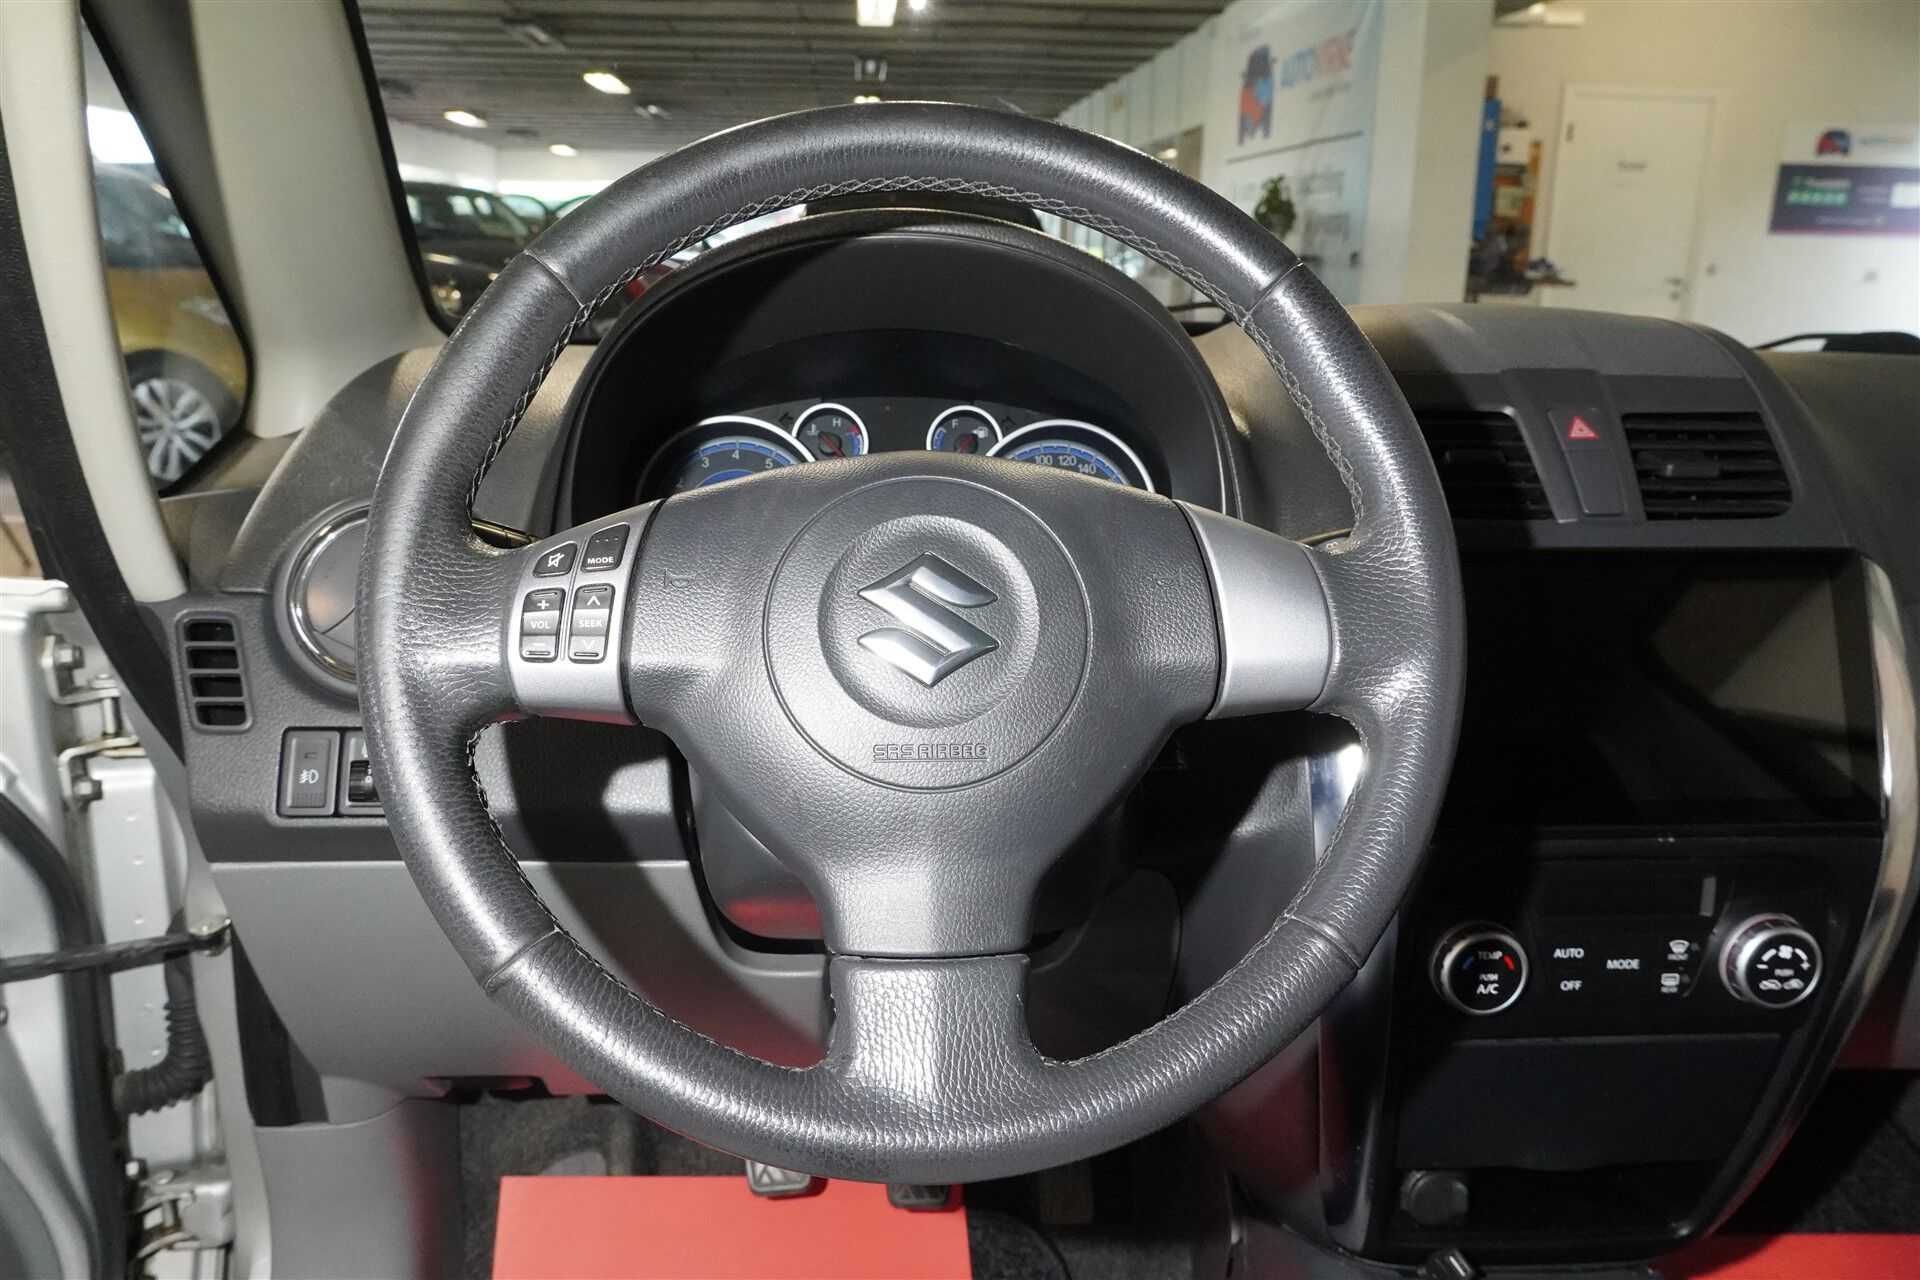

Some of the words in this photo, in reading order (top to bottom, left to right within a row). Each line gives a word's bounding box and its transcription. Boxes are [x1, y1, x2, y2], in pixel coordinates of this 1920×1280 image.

[832, 417, 842, 427] H
[951, 418, 960, 429] F
[731, 449, 740, 460] 4
[701, 457, 710, 468] 3
[765, 458, 774, 469] 5
[1034, 455, 1053, 466] 100
[1057, 455, 1077, 467] 120
[1077, 463, 1096, 475] 140
[587, 556, 614, 565] MODE
[530, 620, 551, 630] VOL
[577, 619, 603, 629] SEEK
[873, 743, 914, 759] SRS
[917, 743, 989, 759] AIRBAG
[1478, 950, 1503, 961] TEMP
[1553, 948, 1585, 959] AUTO
[1606, 958, 1640, 970] MODE
[1476, 983, 1499, 995] A/C
[1559, 980, 1583, 991] OFF
